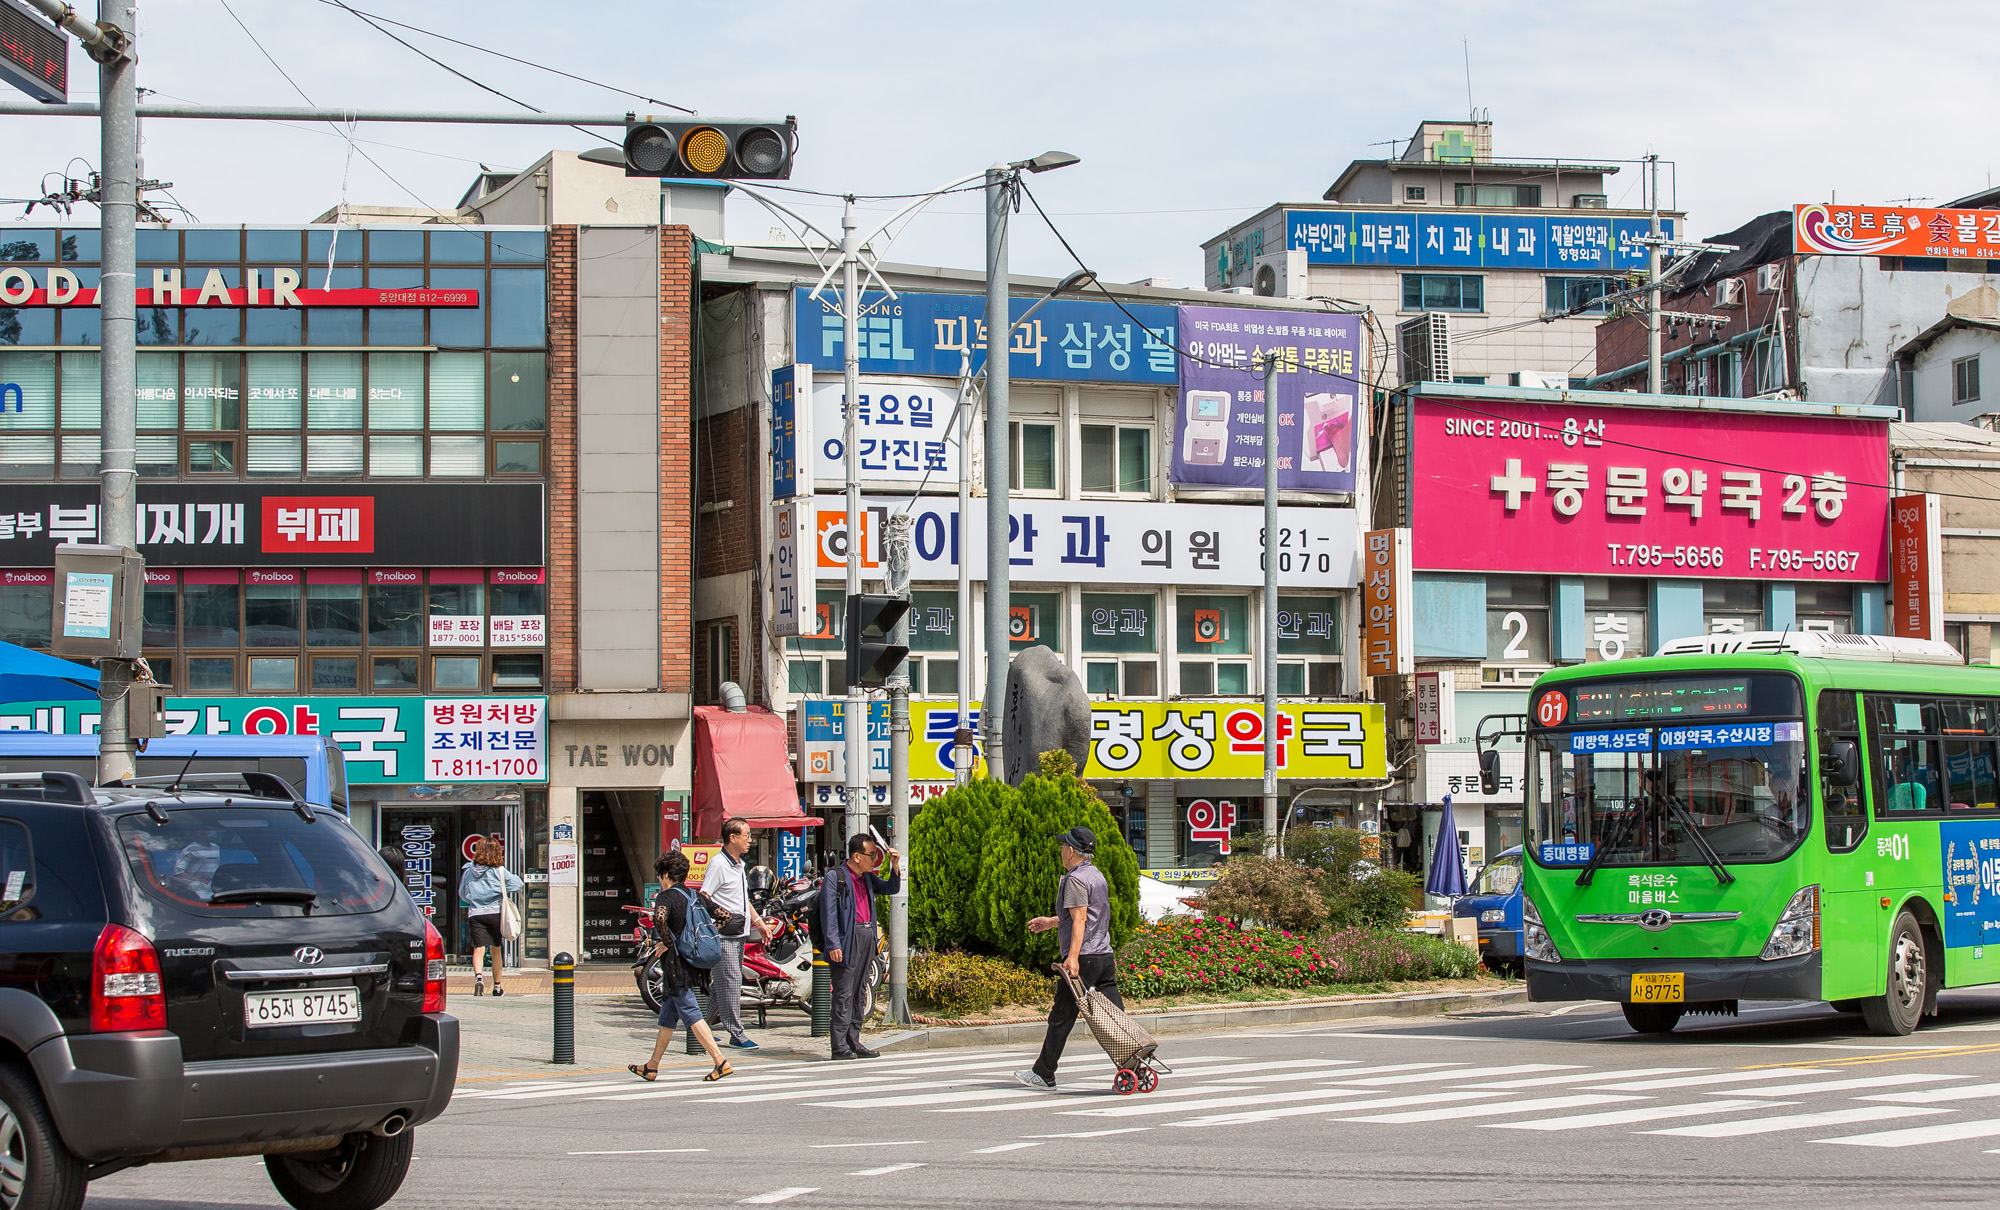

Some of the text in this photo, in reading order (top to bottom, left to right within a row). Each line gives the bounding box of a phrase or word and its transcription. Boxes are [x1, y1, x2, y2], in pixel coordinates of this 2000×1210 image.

[1294, 222, 1346, 253] 산부인과
[1361, 224, 1411, 255] 피부과
[1551, 225, 1608, 248] 재활의학과
[1558, 248, 1601, 262] 정형외과
[0, 267, 304, 307] OD HAIR
[379, 291, 468, 304] 중앙대점 812-6999
[822, 303, 902, 316] SASUNG
[1195, 320, 1209, 332] 미국
[1308, 327, 1322, 338] 치료
[1189, 340, 1204, 369] 약
[1207, 341, 1248, 371] 안먹는
[309, 388, 331, 400] 다른
[335, 388, 356, 400] 나를
[1237, 390, 1252, 402] 통증
[1279, 413, 1295, 427] OK
[1446, 418, 1494, 438] SINCE
[774, 382, 783, 483] 비뇨기과
[785, 380, 795, 481] 피부과
[1235, 434, 1263, 446] 가격부담
[1277, 456, 1293, 470] OK
[1546, 461, 1848, 521] 중문약국 2층
[49, 503, 245, 545] 부찌개
[277, 507, 361, 543] 뷔페
[1608, 544, 1860, 573] T.795-5656 F.795-5667
[14, 572, 47, 582] nolboo
[260, 571, 294, 582] nolboo
[382, 571, 417, 581] nolboo
[506, 571, 538, 581] nolboo
[778, 545, 794, 619] 안과
[1368, 532, 1394, 672] 명성약국
[432, 620, 480, 631] 배달 포장
[493, 619, 541, 631] 배달 포장
[776, 622, 798, 633] 821-0070
[1091, 608, 1147, 636] 안과
[1277, 610, 1334, 640] 안과
[432, 634, 480, 643] 1877-0001
[432, 703, 538, 725] 병원처방
[1541, 702, 1562, 723] 01
[432, 730, 538, 752] 조제전문
[1574, 731, 1650, 750] 대방역,상도역
[1660, 727, 1771, 746] 이화약국,수산시장
[565, 744, 674, 767] TAE WON
[432, 758, 538, 778] T.811-1700
[1448, 776, 1513, 794] 중문국
[1187, 799, 1237, 856] 약
[1543, 846, 1590, 862] 중대병원
[1628, 874, 1678, 888] 흑석운수
[1628, 890, 1680, 905] 마을버스
[164, 947, 216, 957] TUCSON
[258, 993, 349, 1020] 65저 8745
